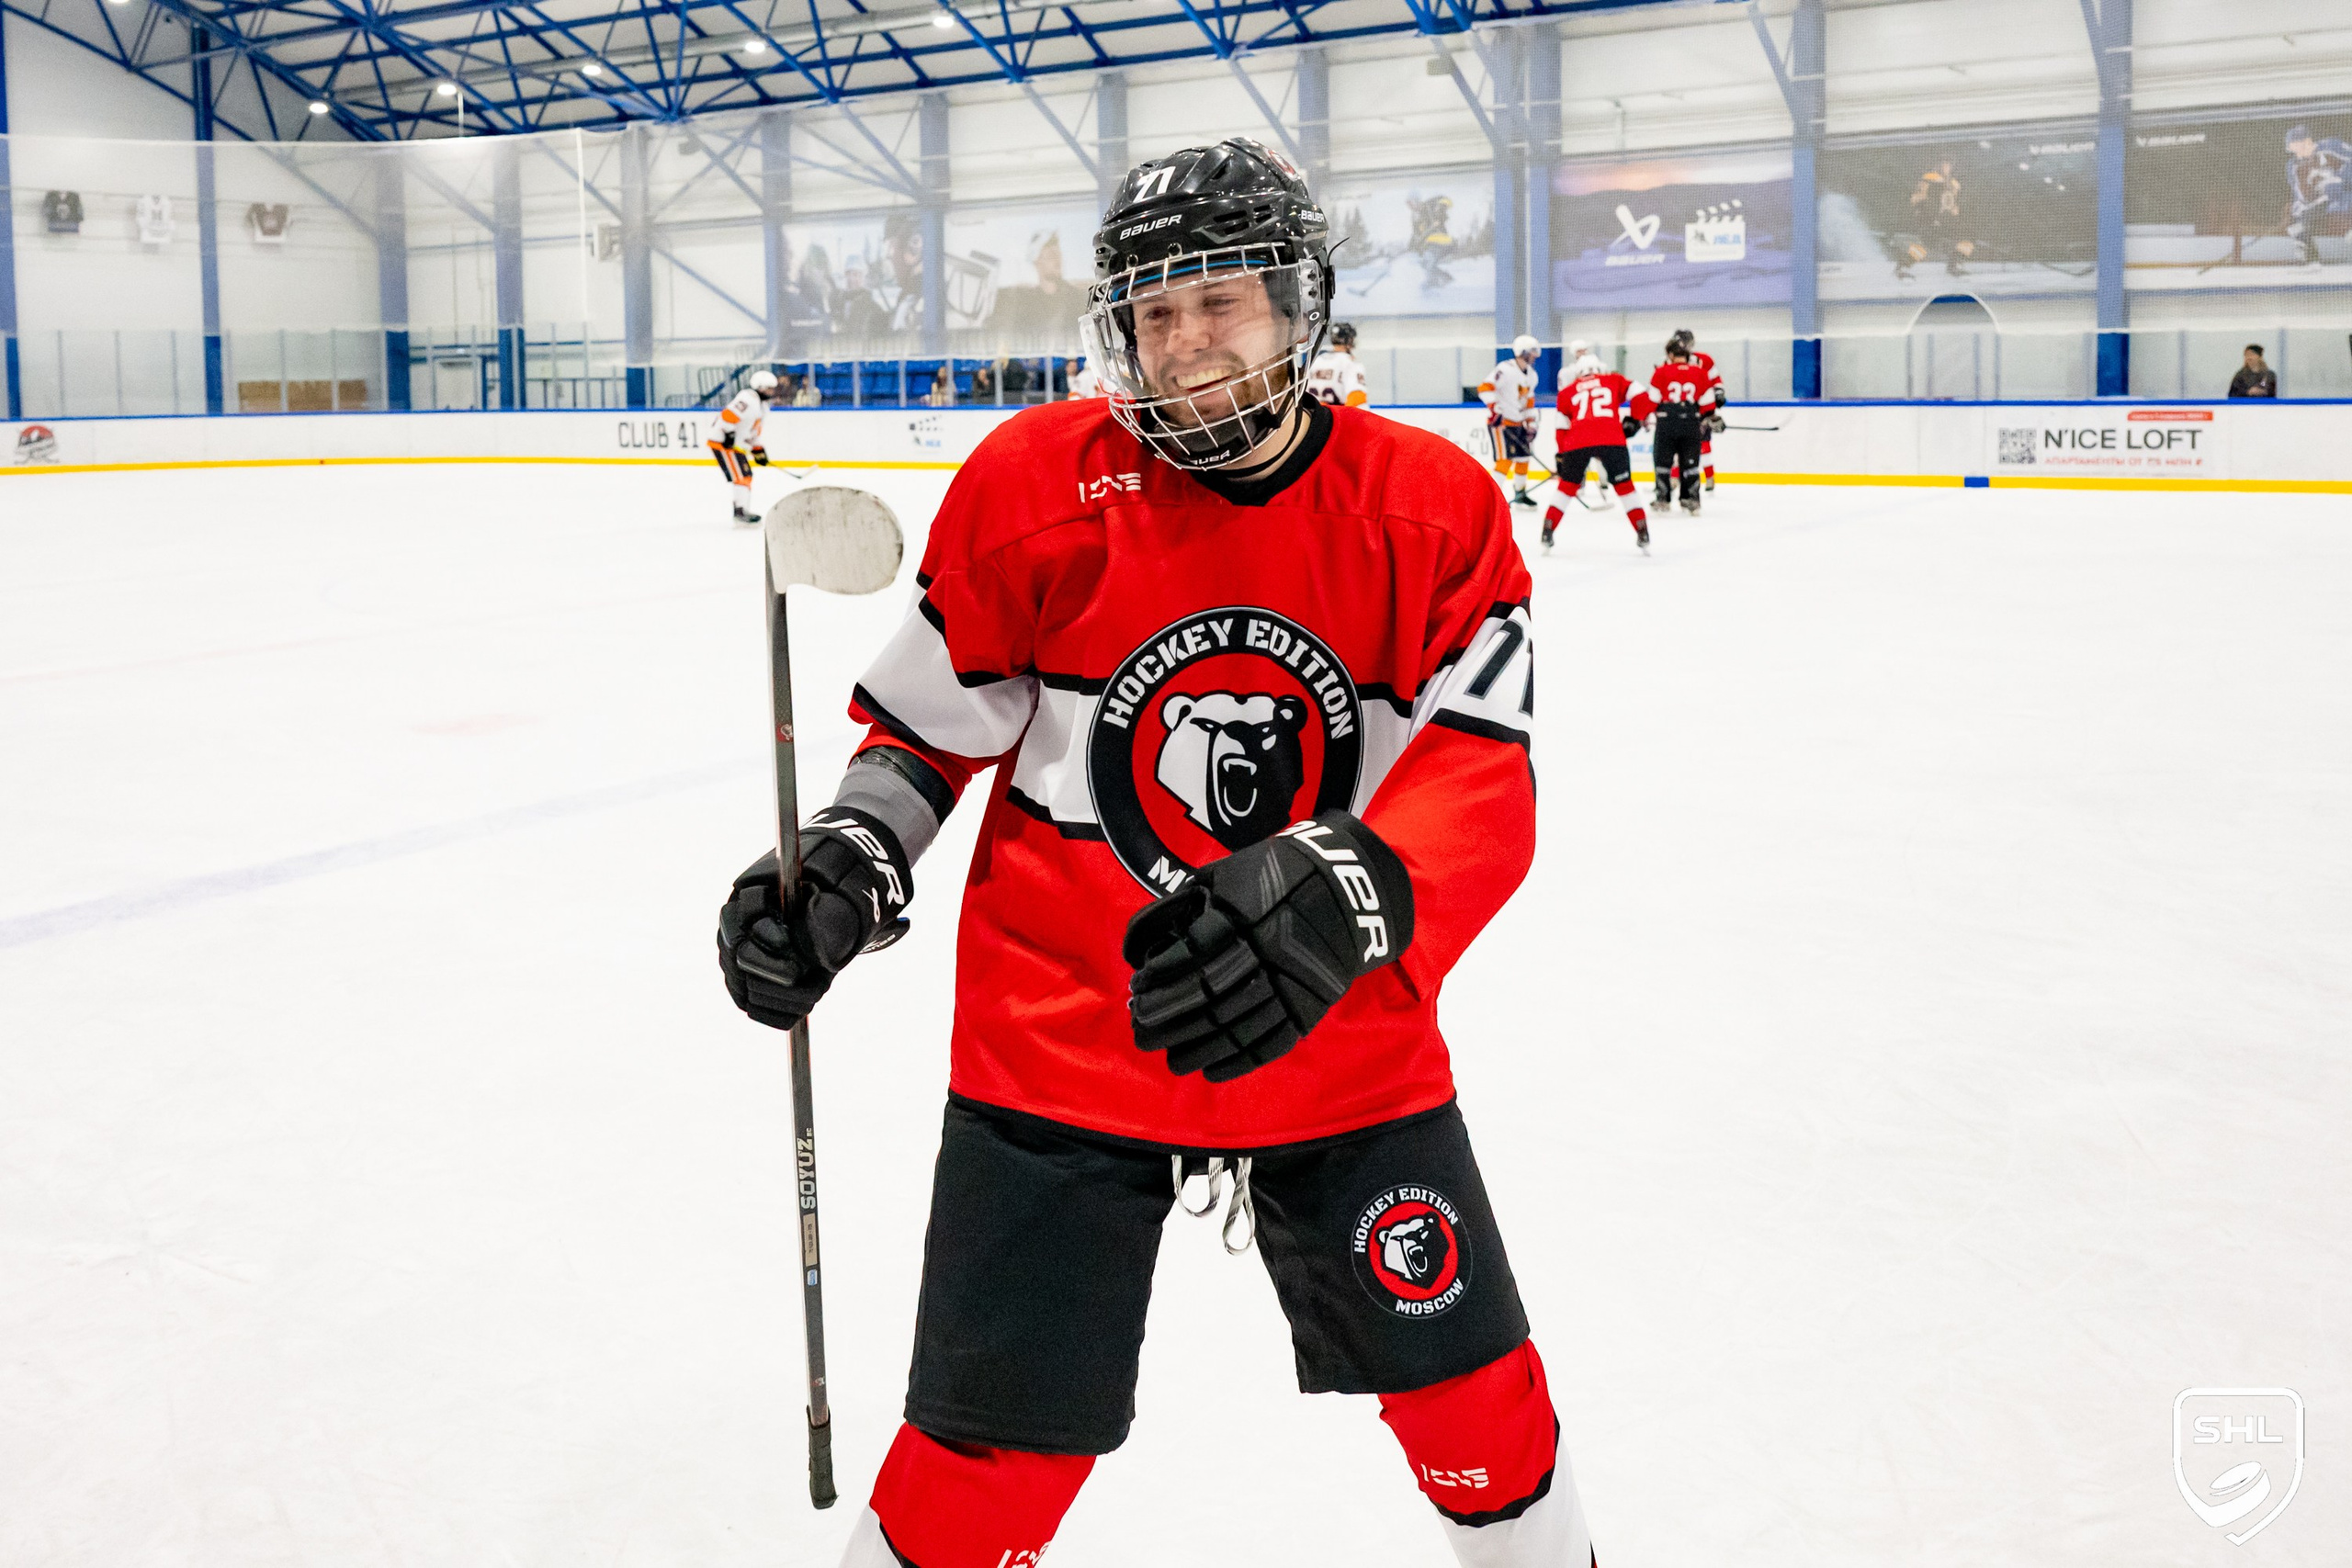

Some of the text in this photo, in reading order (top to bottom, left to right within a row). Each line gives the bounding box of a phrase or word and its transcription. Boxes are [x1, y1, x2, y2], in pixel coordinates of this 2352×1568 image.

[1119, 214, 1182, 241] BAUER
[1571, 387, 1614, 421] 72
[618, 422, 699, 448] CLUB 41
[2044, 429, 2203, 450] N'ICE LOFT
[1102, 618, 1354, 739] HOCKEY EDITION
[797, 1137, 816, 1210] SOYUZ
[1354, 1188, 1459, 1253] HOCKEY EDITION
[1395, 1278, 1464, 1315] MOSCOW
